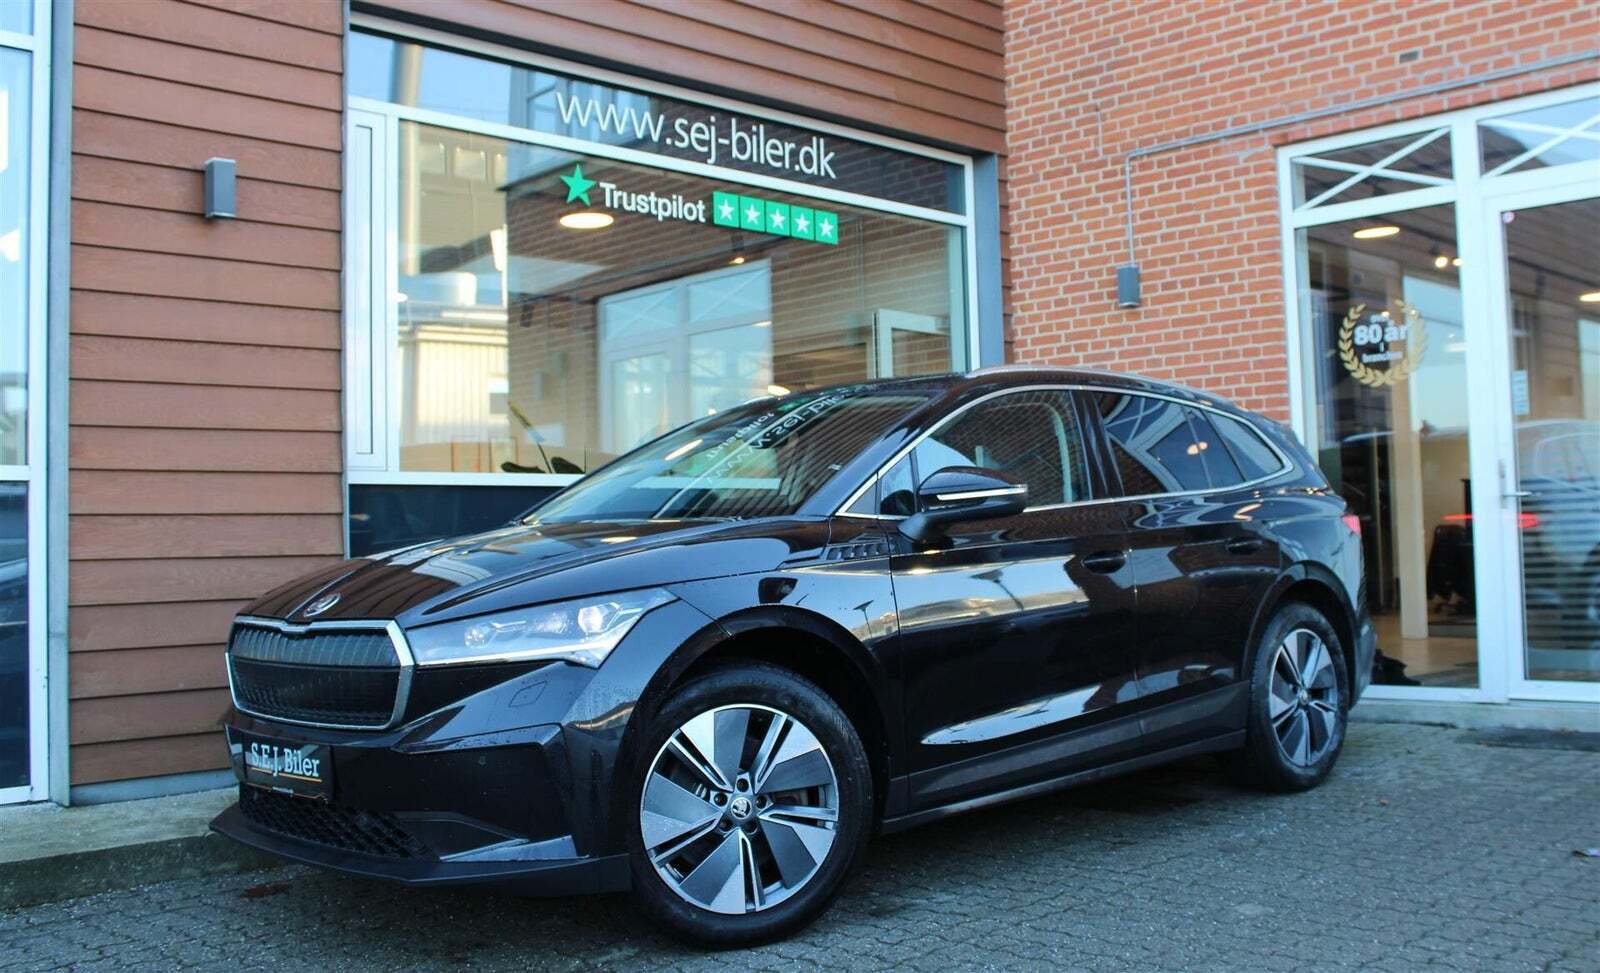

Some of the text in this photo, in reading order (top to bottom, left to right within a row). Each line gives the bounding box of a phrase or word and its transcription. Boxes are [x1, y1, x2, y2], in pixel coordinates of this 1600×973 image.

[556, 91, 837, 179] www.sej-biler.dk
[599, 181, 706, 223] Trustpilot
[1353, 323, 1383, 346] 80
[251, 741, 321, 777] S.E.J. Biler
